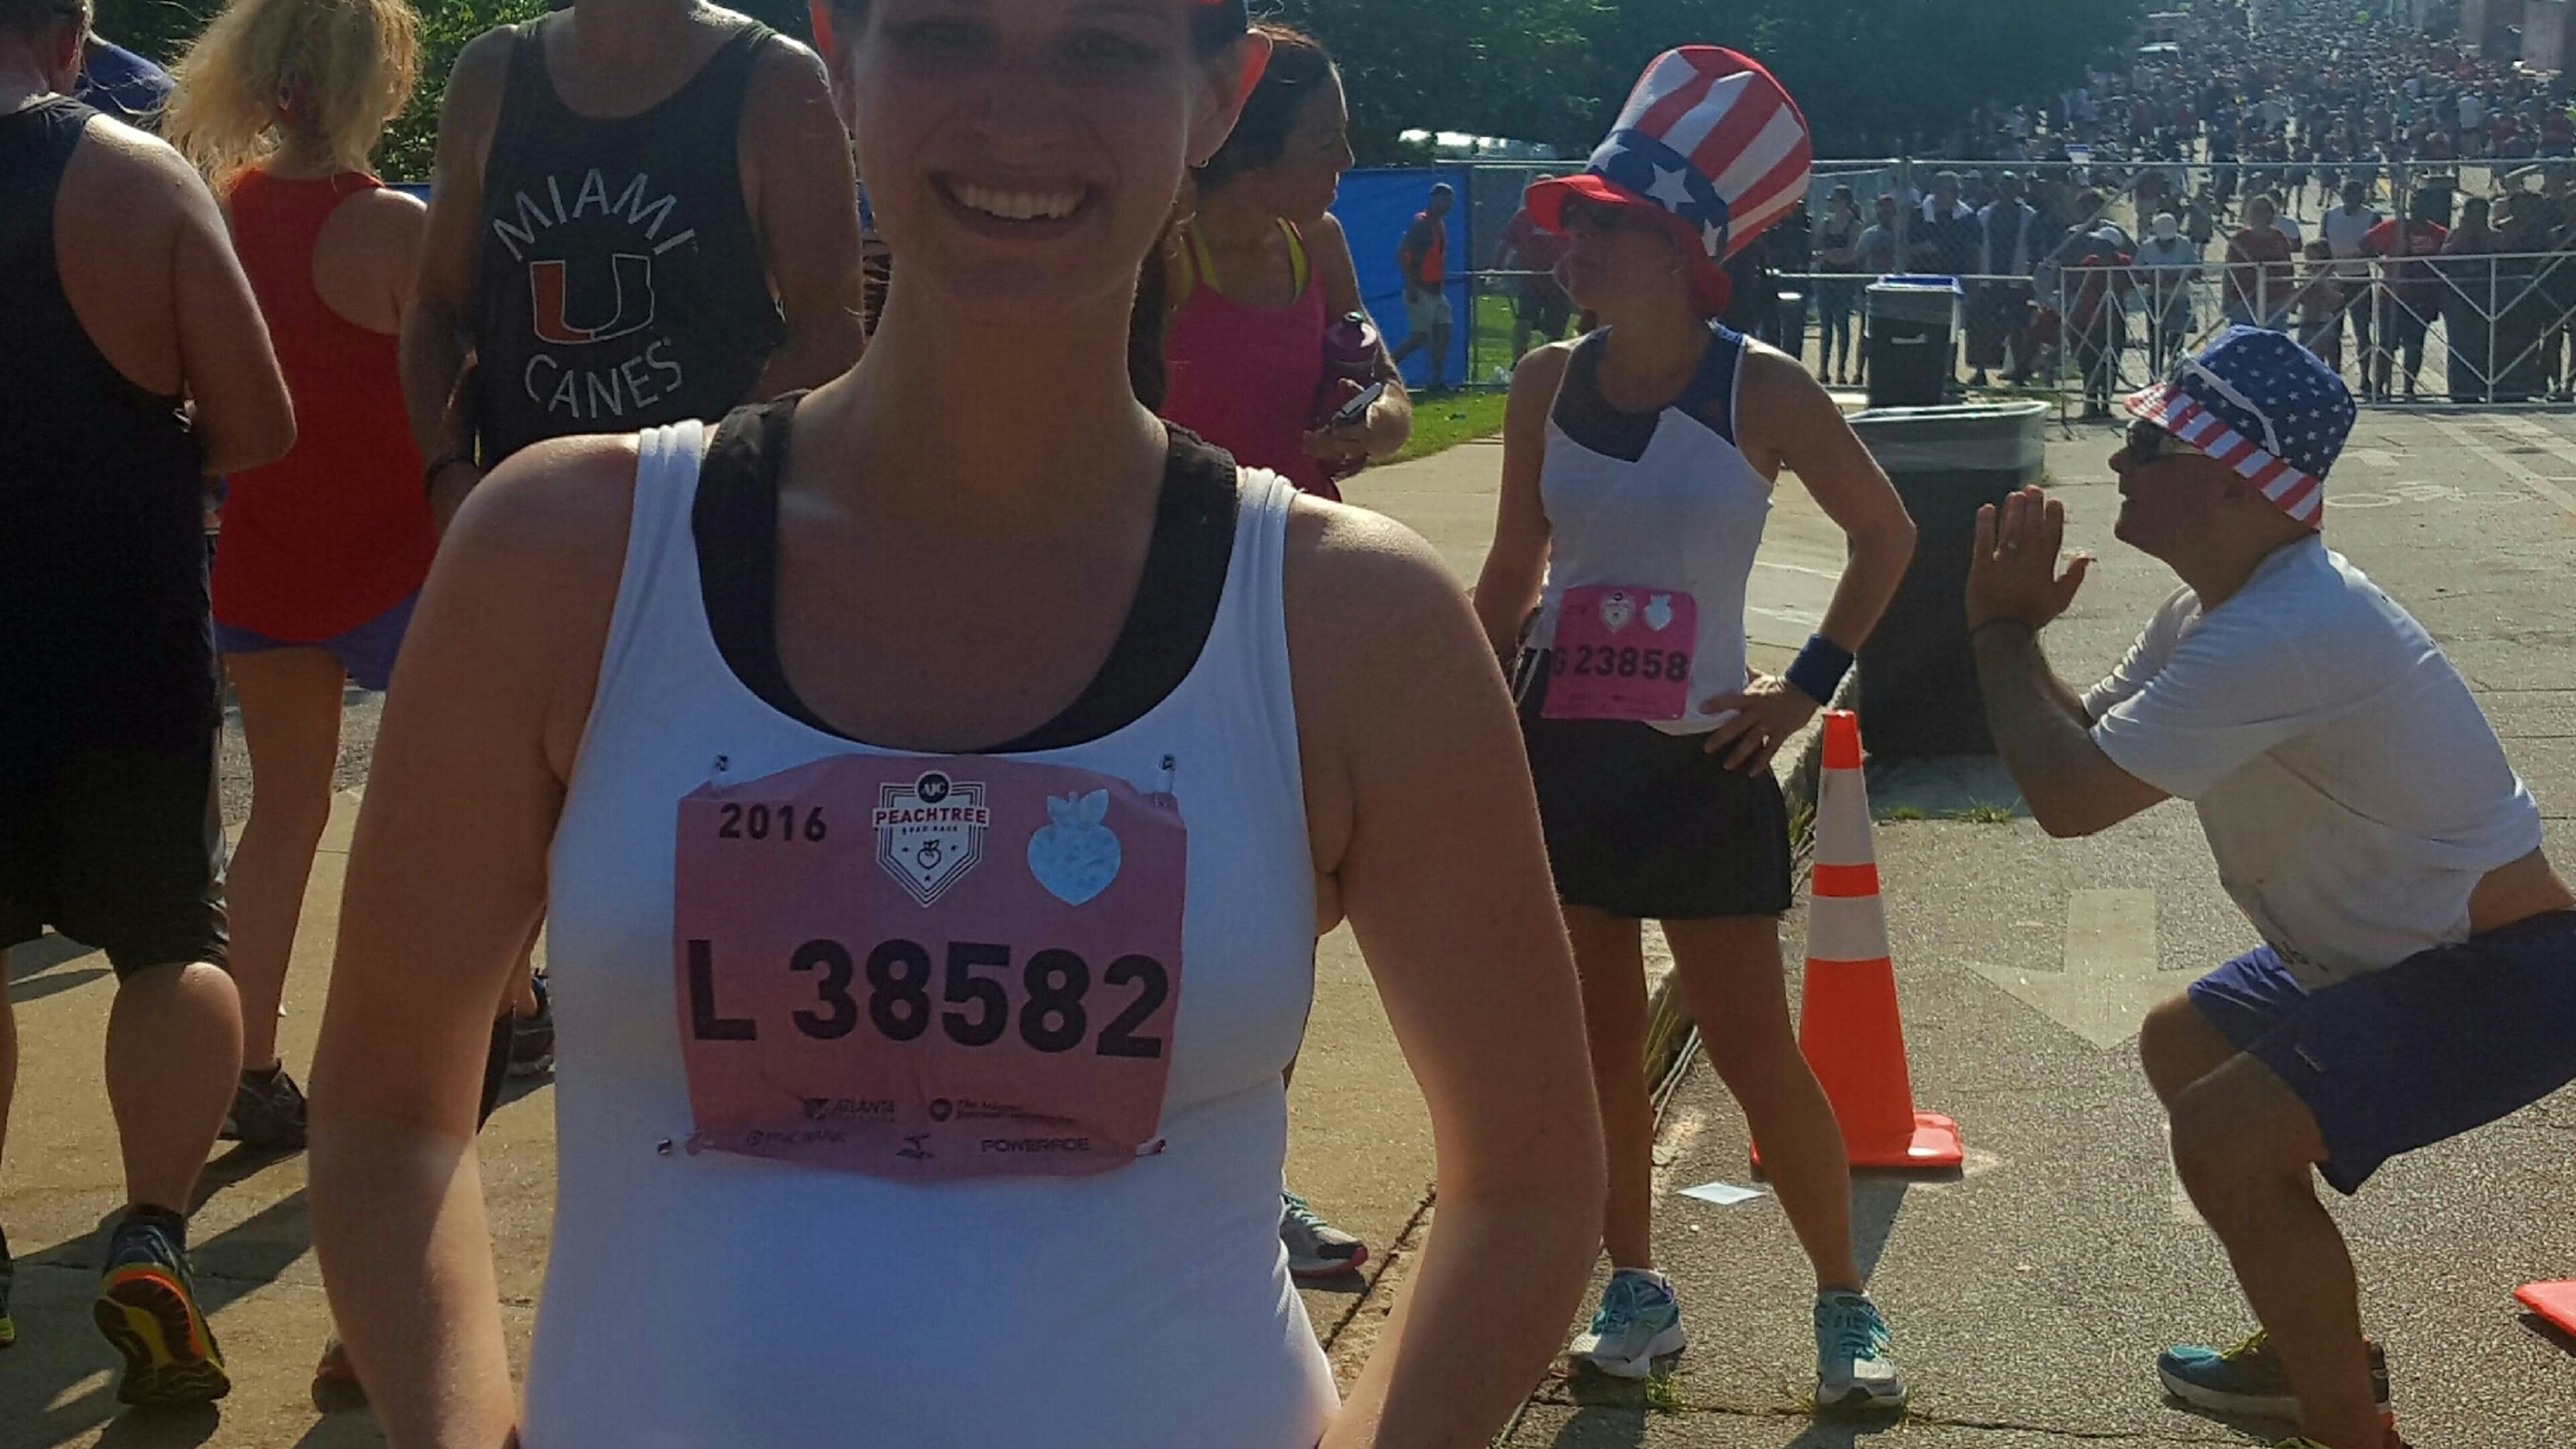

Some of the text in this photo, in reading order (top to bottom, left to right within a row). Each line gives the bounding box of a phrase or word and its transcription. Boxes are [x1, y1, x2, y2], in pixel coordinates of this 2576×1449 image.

[493, 168, 695, 262] MIAMI
[529, 253, 655, 344] U
[525, 337, 682, 419] CANES
[1574, 644, 1689, 682] 23858
[875, 807, 987, 825] PEACHTREE
[921, 782, 946, 797] AJC
[719, 803, 826, 842] 2016
[686, 938, 1169, 1059] L 38582
